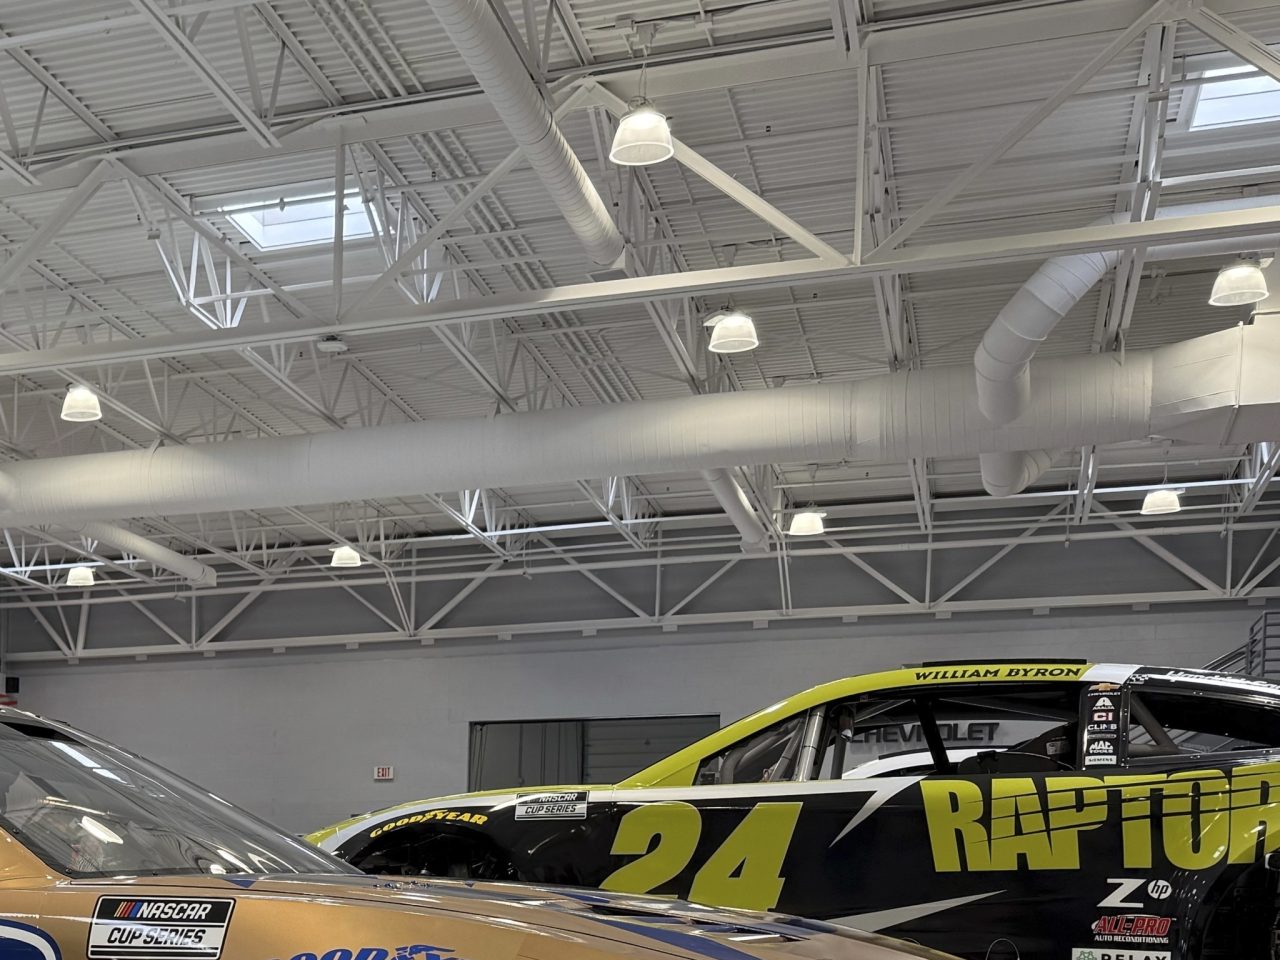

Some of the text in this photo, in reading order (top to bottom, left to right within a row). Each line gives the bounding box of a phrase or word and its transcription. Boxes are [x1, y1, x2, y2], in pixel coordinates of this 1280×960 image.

[915, 668, 1081, 681] WILLIAM BYRON
[1089, 740, 1114, 750] MAC
[377, 767, 390, 778] EXIT
[525, 804, 577, 814] CUP SERIES
[920, 762, 1280, 872] RAPTOR
[370, 809, 489, 838] GOODYEAR
[600, 801, 804, 912] 24
[1151, 880, 1170, 899] hp
[136, 902, 212, 920] NASCAR
[1093, 915, 1172, 936] ALL-PRO
[107, 927, 206, 946] CUP SERIES
[1114, 935, 1169, 944] RECONDITIONING
